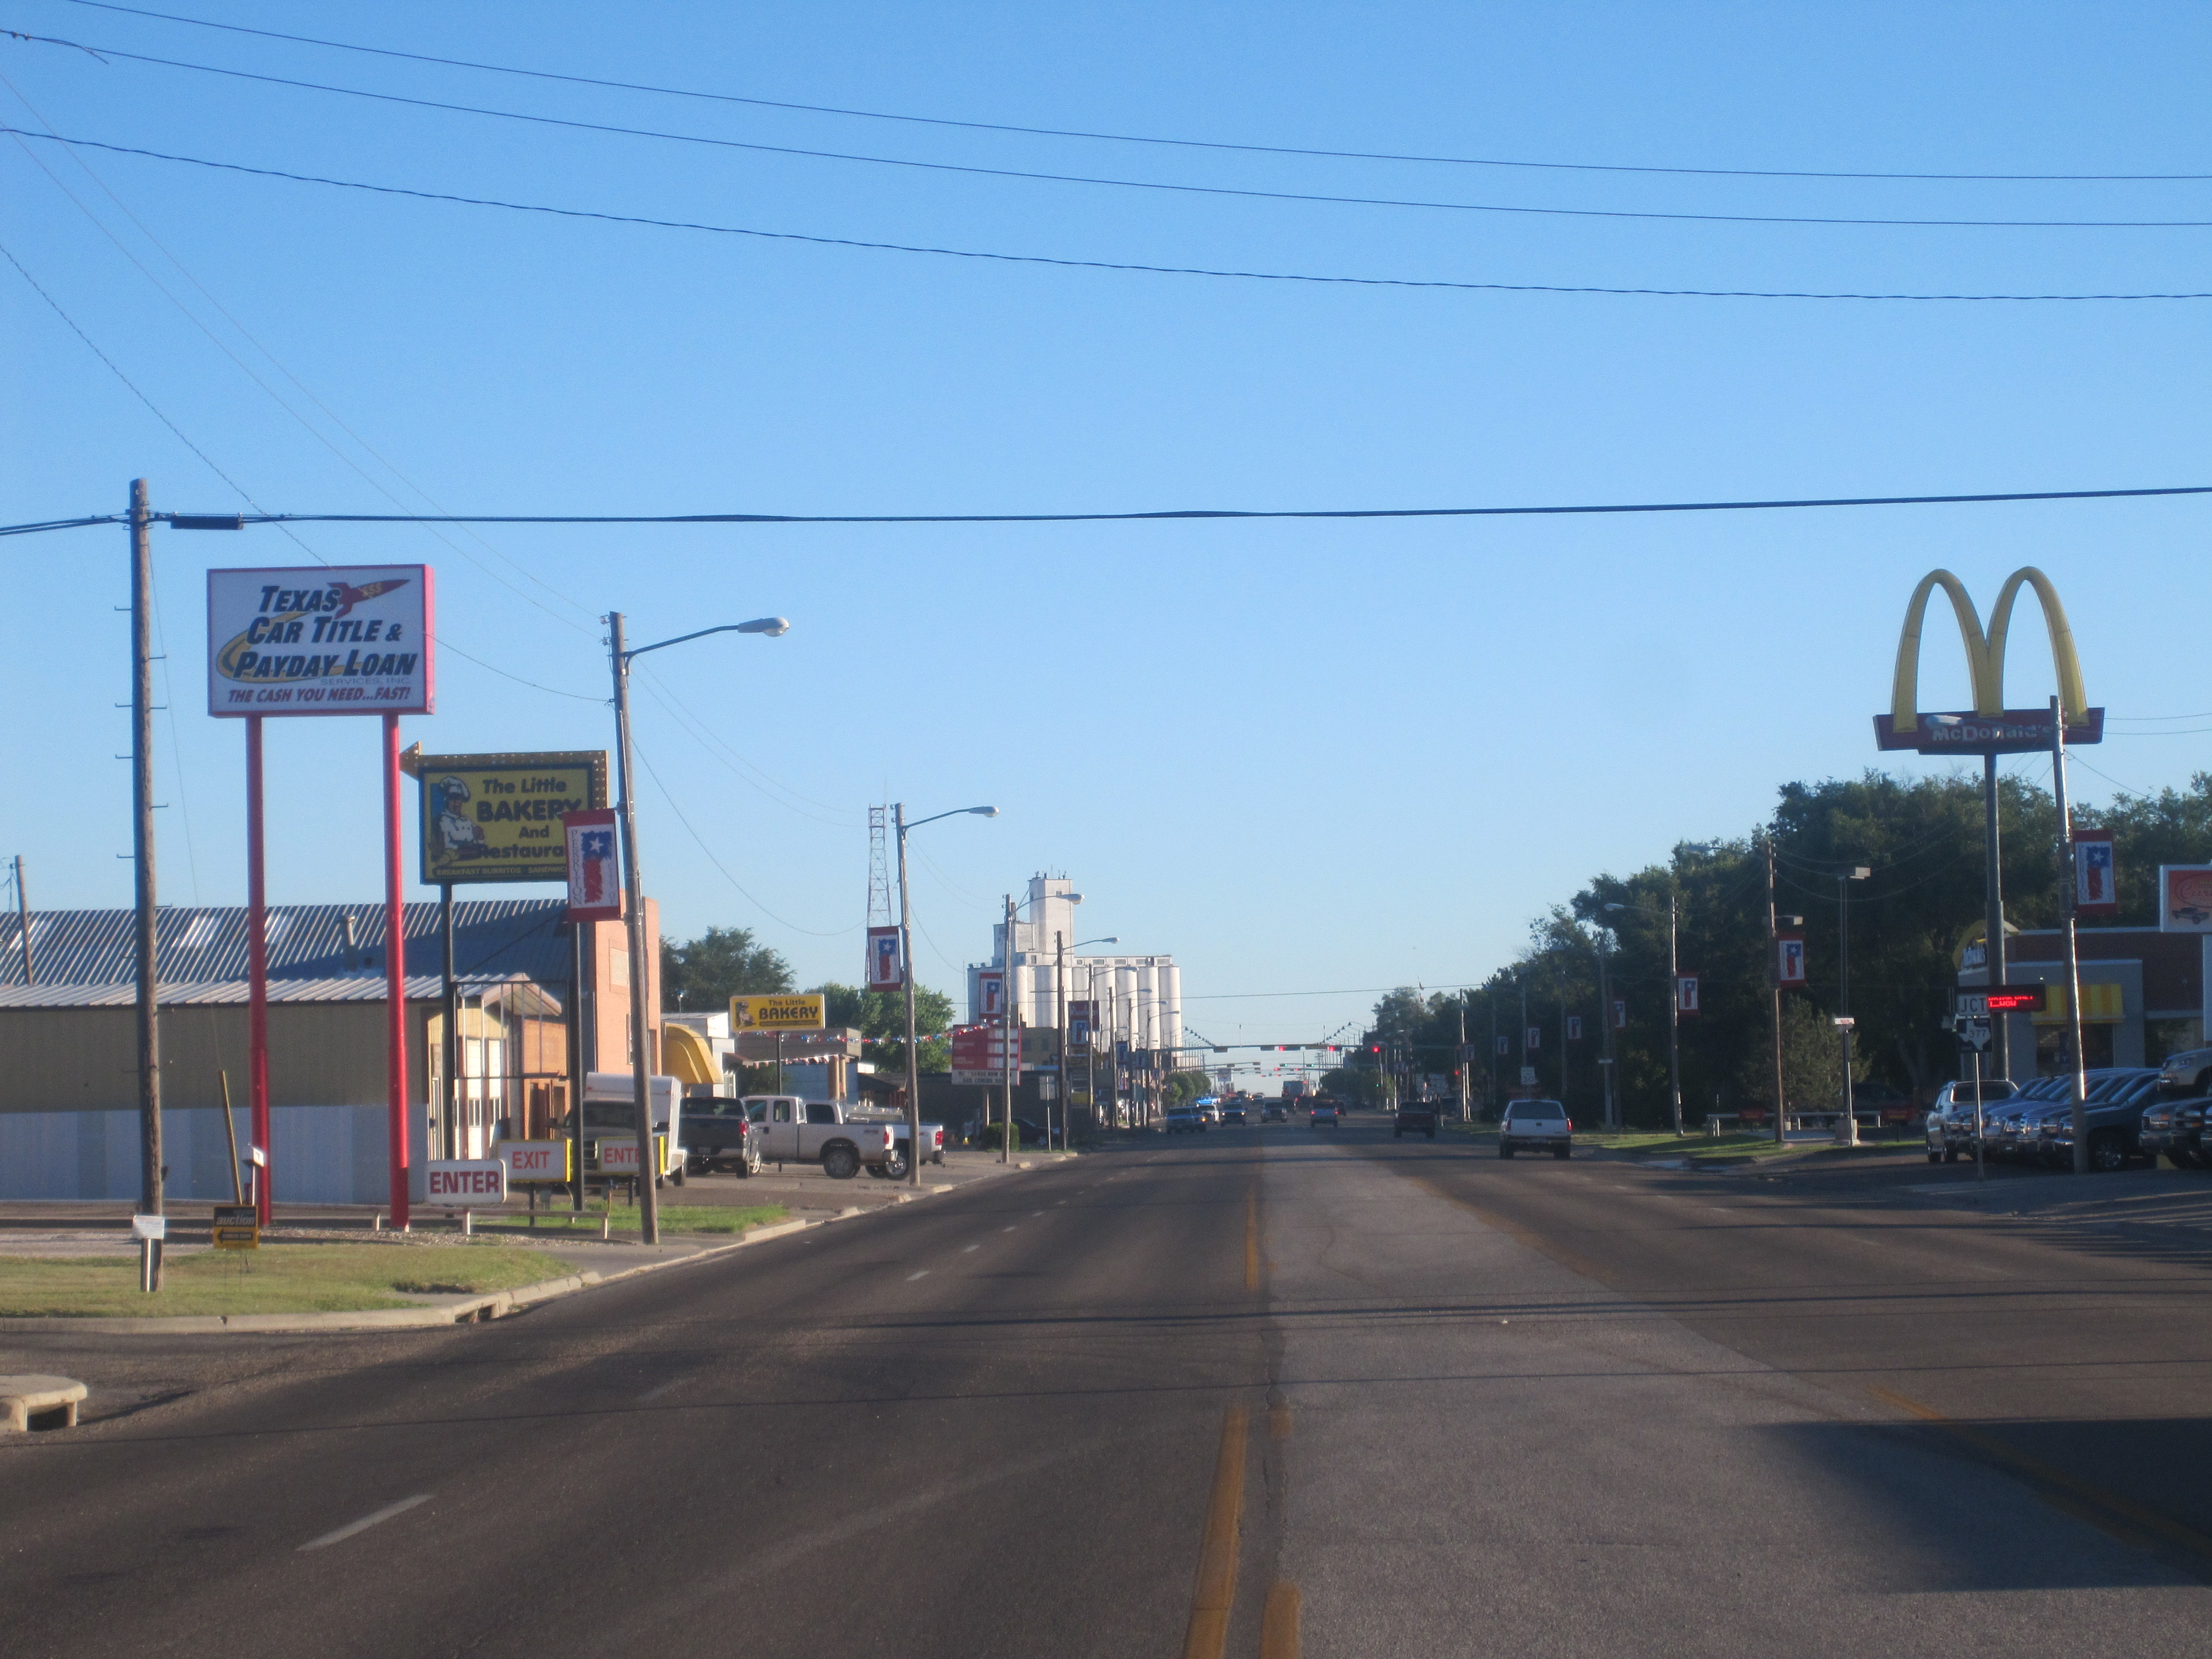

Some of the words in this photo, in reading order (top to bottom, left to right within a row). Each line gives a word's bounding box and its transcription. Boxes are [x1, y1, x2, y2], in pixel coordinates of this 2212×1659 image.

[258, 586, 341, 613] TEXAS
[246, 616, 304, 645] CAR
[311, 615, 383, 643] TITLE
[385, 623, 403, 642] &
[232, 651, 341, 679] PAYDAY
[343, 649, 418, 676] LOAN
[228, 689, 253, 703] THE
[255, 688, 293, 703] CASH
[296, 687, 326, 702] YOU
[482, 779, 515, 794] The
[521, 776, 567, 794] Little
[476, 797, 582, 822] BAKERY
[518, 825, 550, 839] And
[478, 843, 565, 859] Restaura
[571, 830, 582, 905] PERRYTON
[759, 1006, 818, 1020] BAKERY
[1960, 998, 1986, 1012] JCT
[1969, 1029, 1986, 1038] 377
[512, 1150, 551, 1170] EXIT
[429, 1170, 500, 1194] ENTER
[216, 1215, 255, 1226] auction
